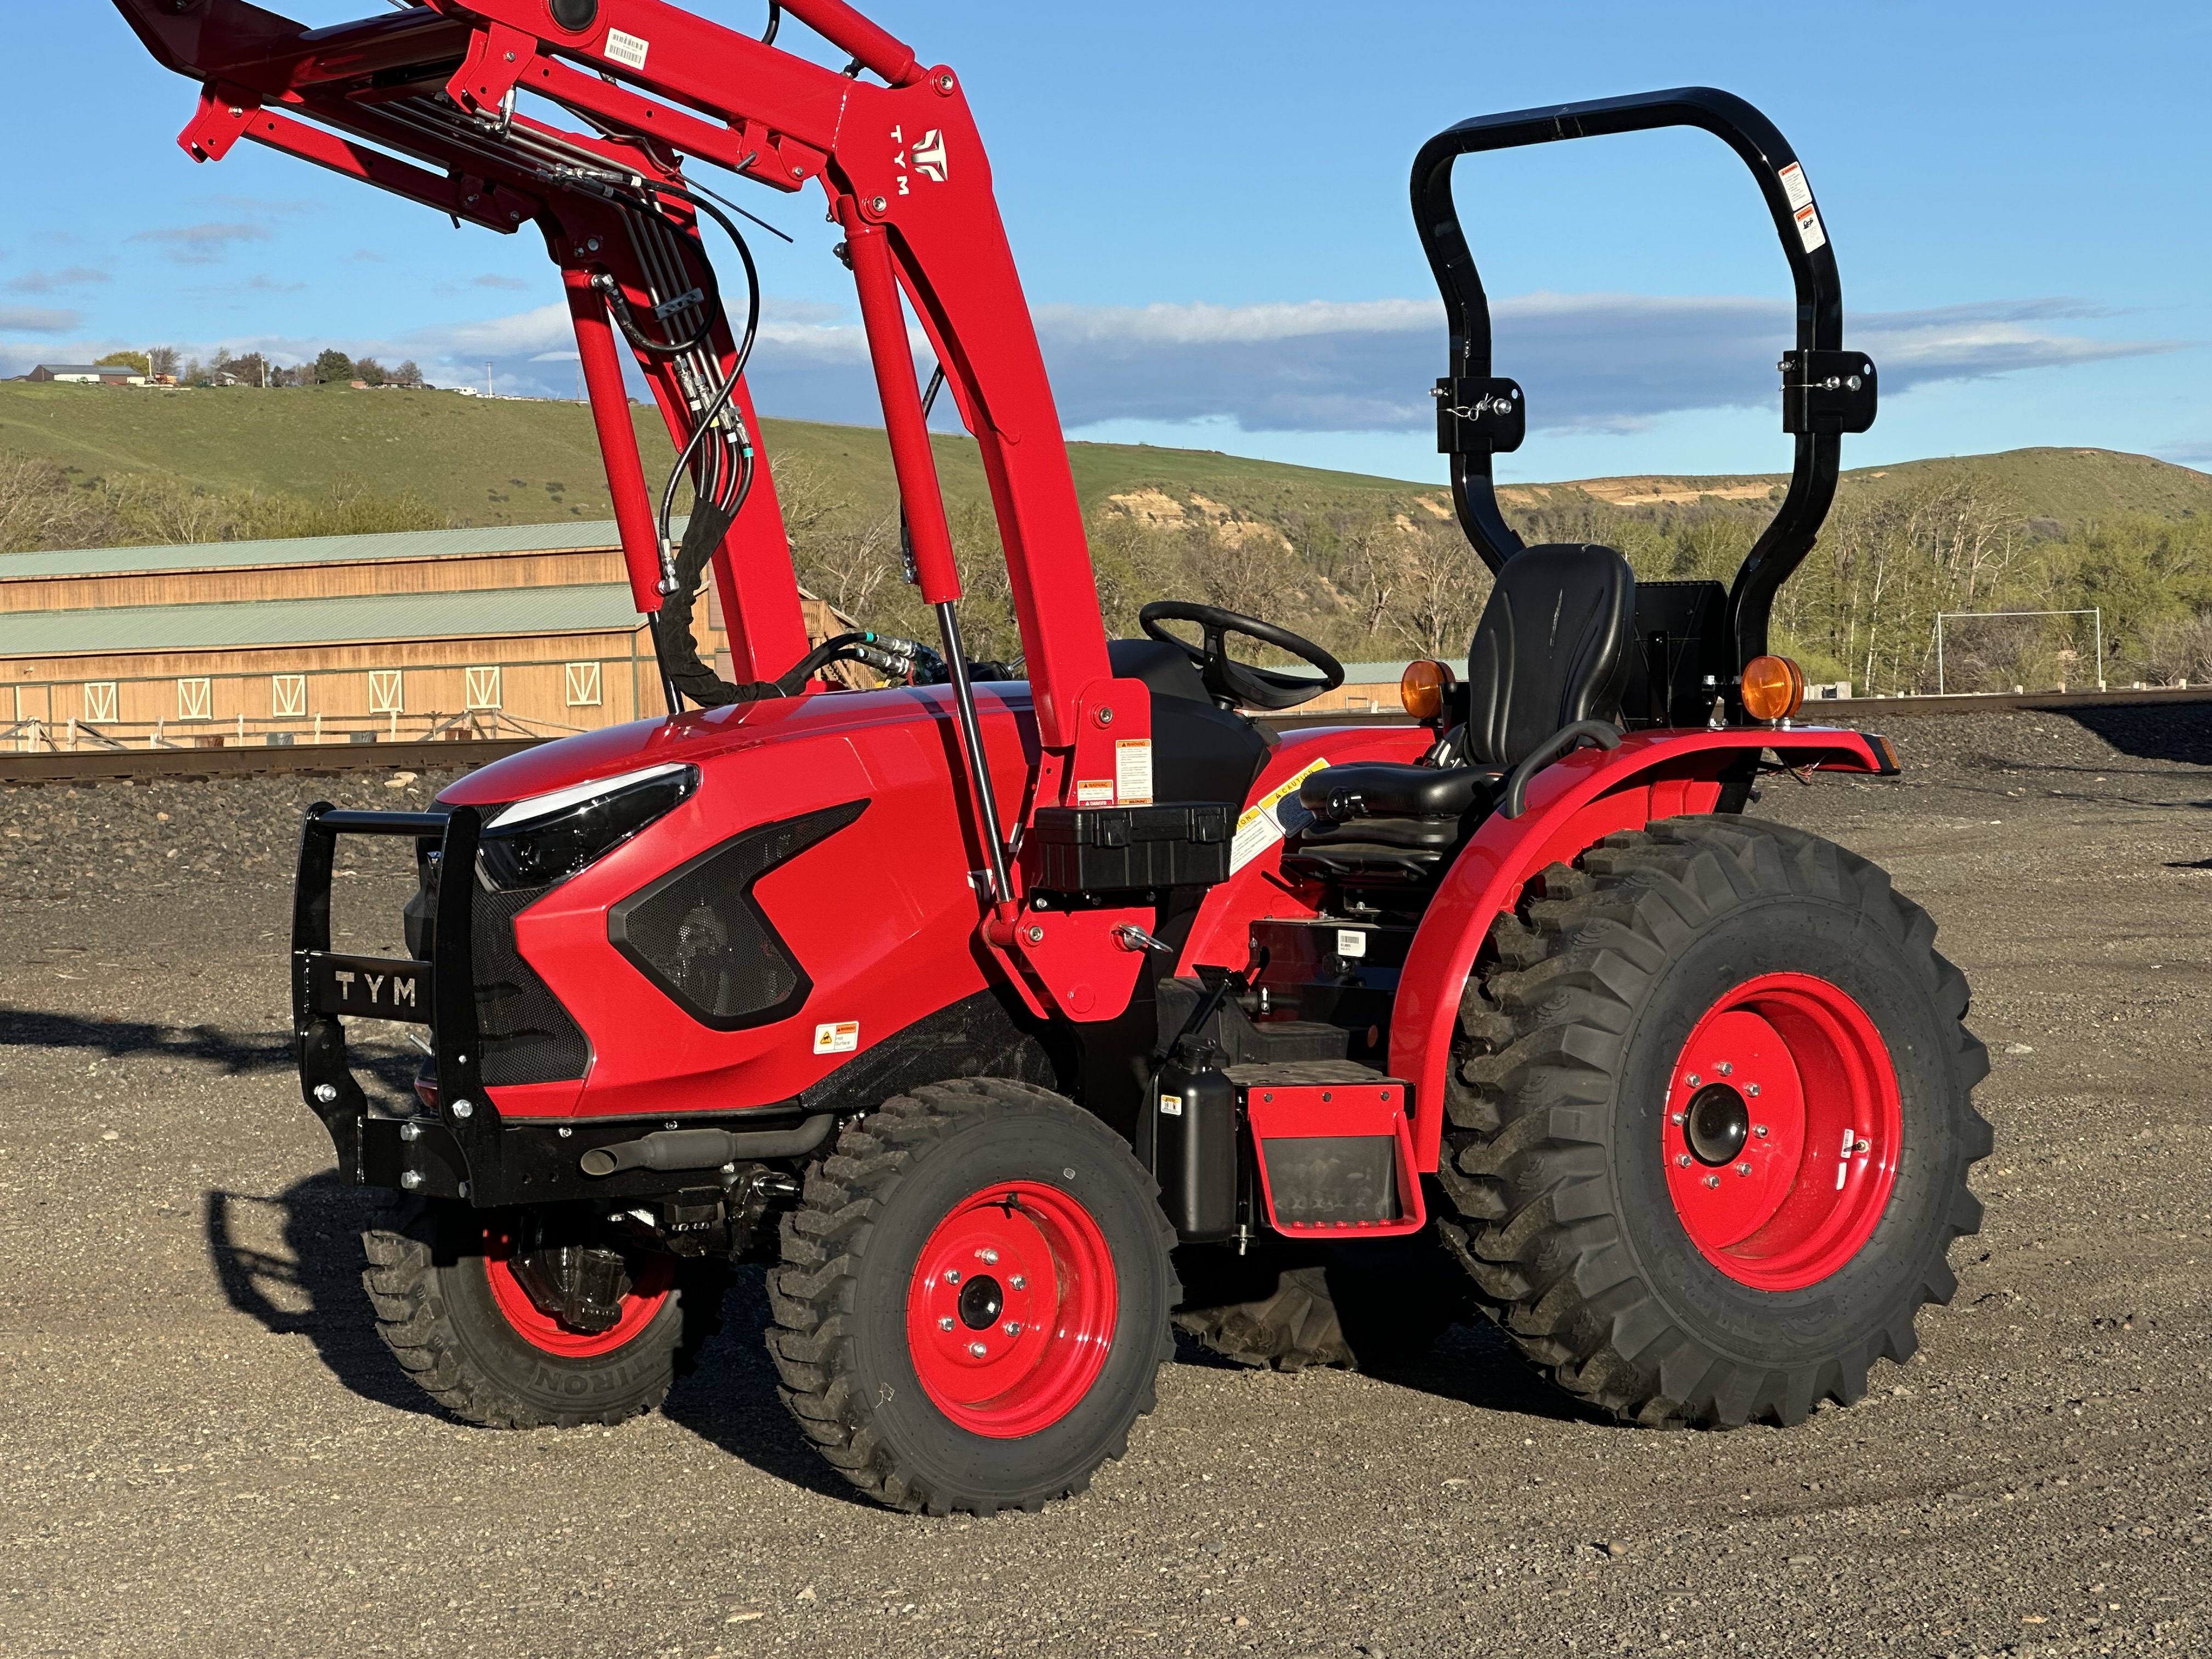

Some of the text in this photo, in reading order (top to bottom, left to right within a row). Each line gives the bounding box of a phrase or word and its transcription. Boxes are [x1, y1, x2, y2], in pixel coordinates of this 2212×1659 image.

[890, 125, 909, 195] TYM
[1282, 769, 1313, 794] CAUTION
[335, 970, 415, 1007] TYM
[534, 1357, 654, 1395] TIRON
